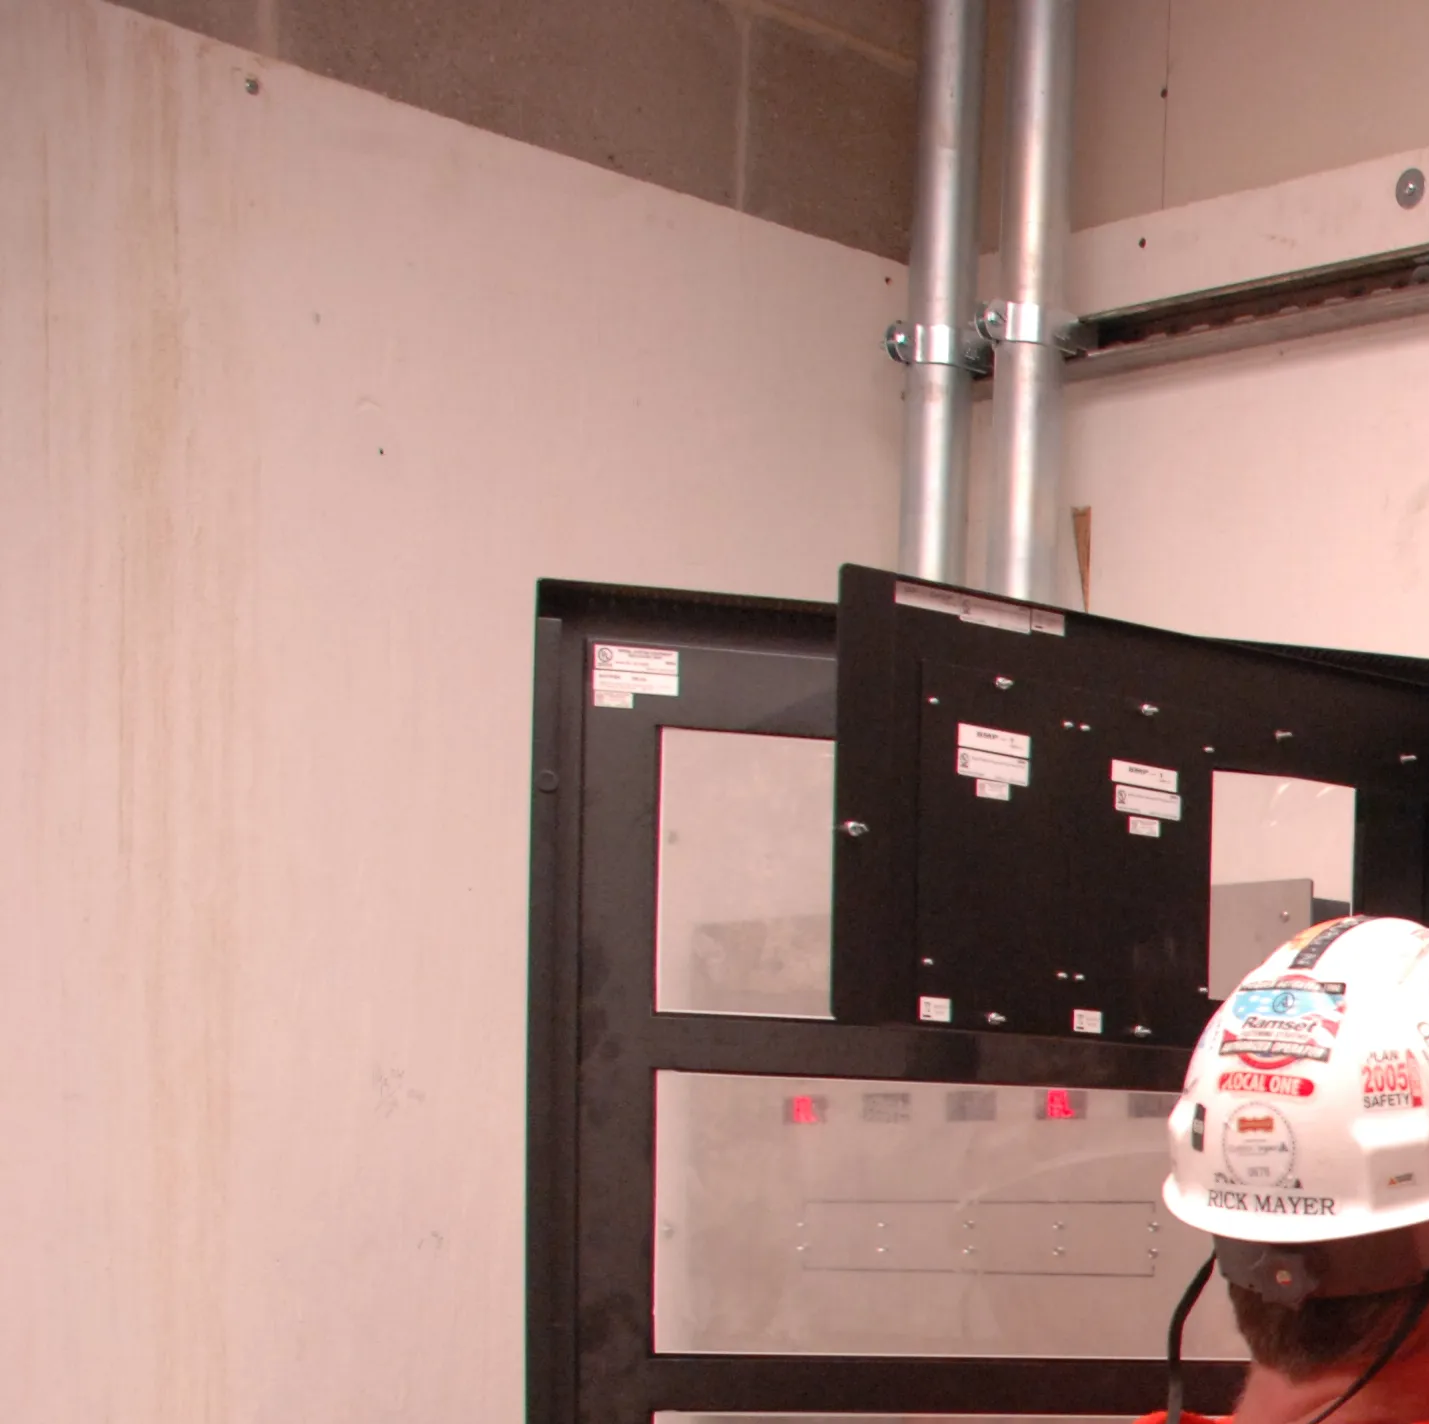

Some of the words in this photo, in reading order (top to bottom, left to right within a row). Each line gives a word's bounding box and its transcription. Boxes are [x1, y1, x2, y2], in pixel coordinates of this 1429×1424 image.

[1242, 1016, 1318, 1033] Ramset
[1223, 1073, 1267, 1091] LOCAL
[1269, 1075, 1300, 1095] ONE
[1362, 1063, 1408, 1093] 2005
[1363, 1094, 1410, 1109] SAFETY
[1208, 1189, 1248, 1211] RICK
[1254, 1194, 1336, 1216] MAYER
